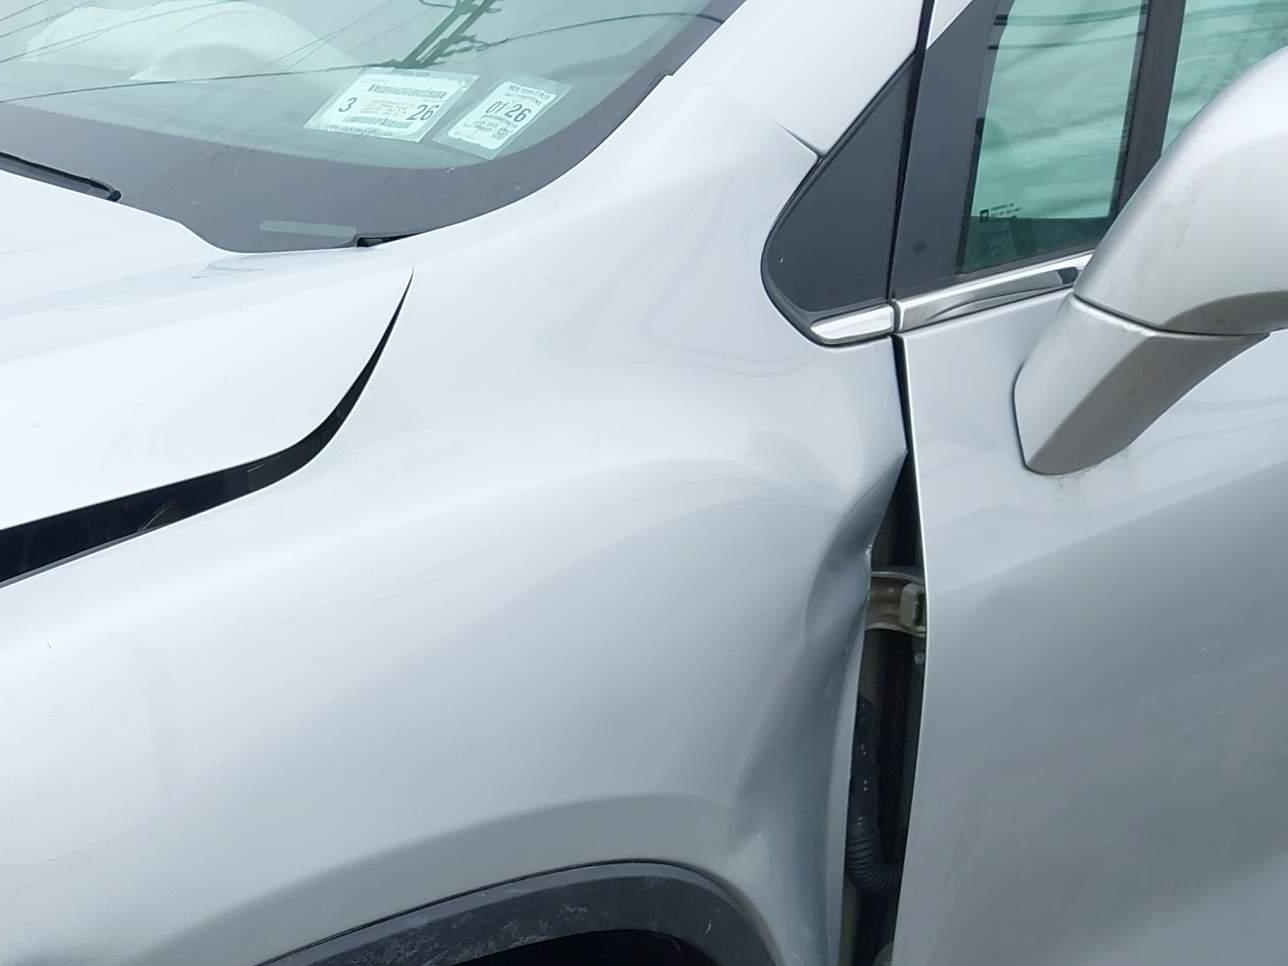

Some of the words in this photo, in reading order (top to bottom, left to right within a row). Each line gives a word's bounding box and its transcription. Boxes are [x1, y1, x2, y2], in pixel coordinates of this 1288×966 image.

[338, 97, 358, 112] 3
[406, 104, 440, 121] 26
[504, 103, 532, 122] 26
